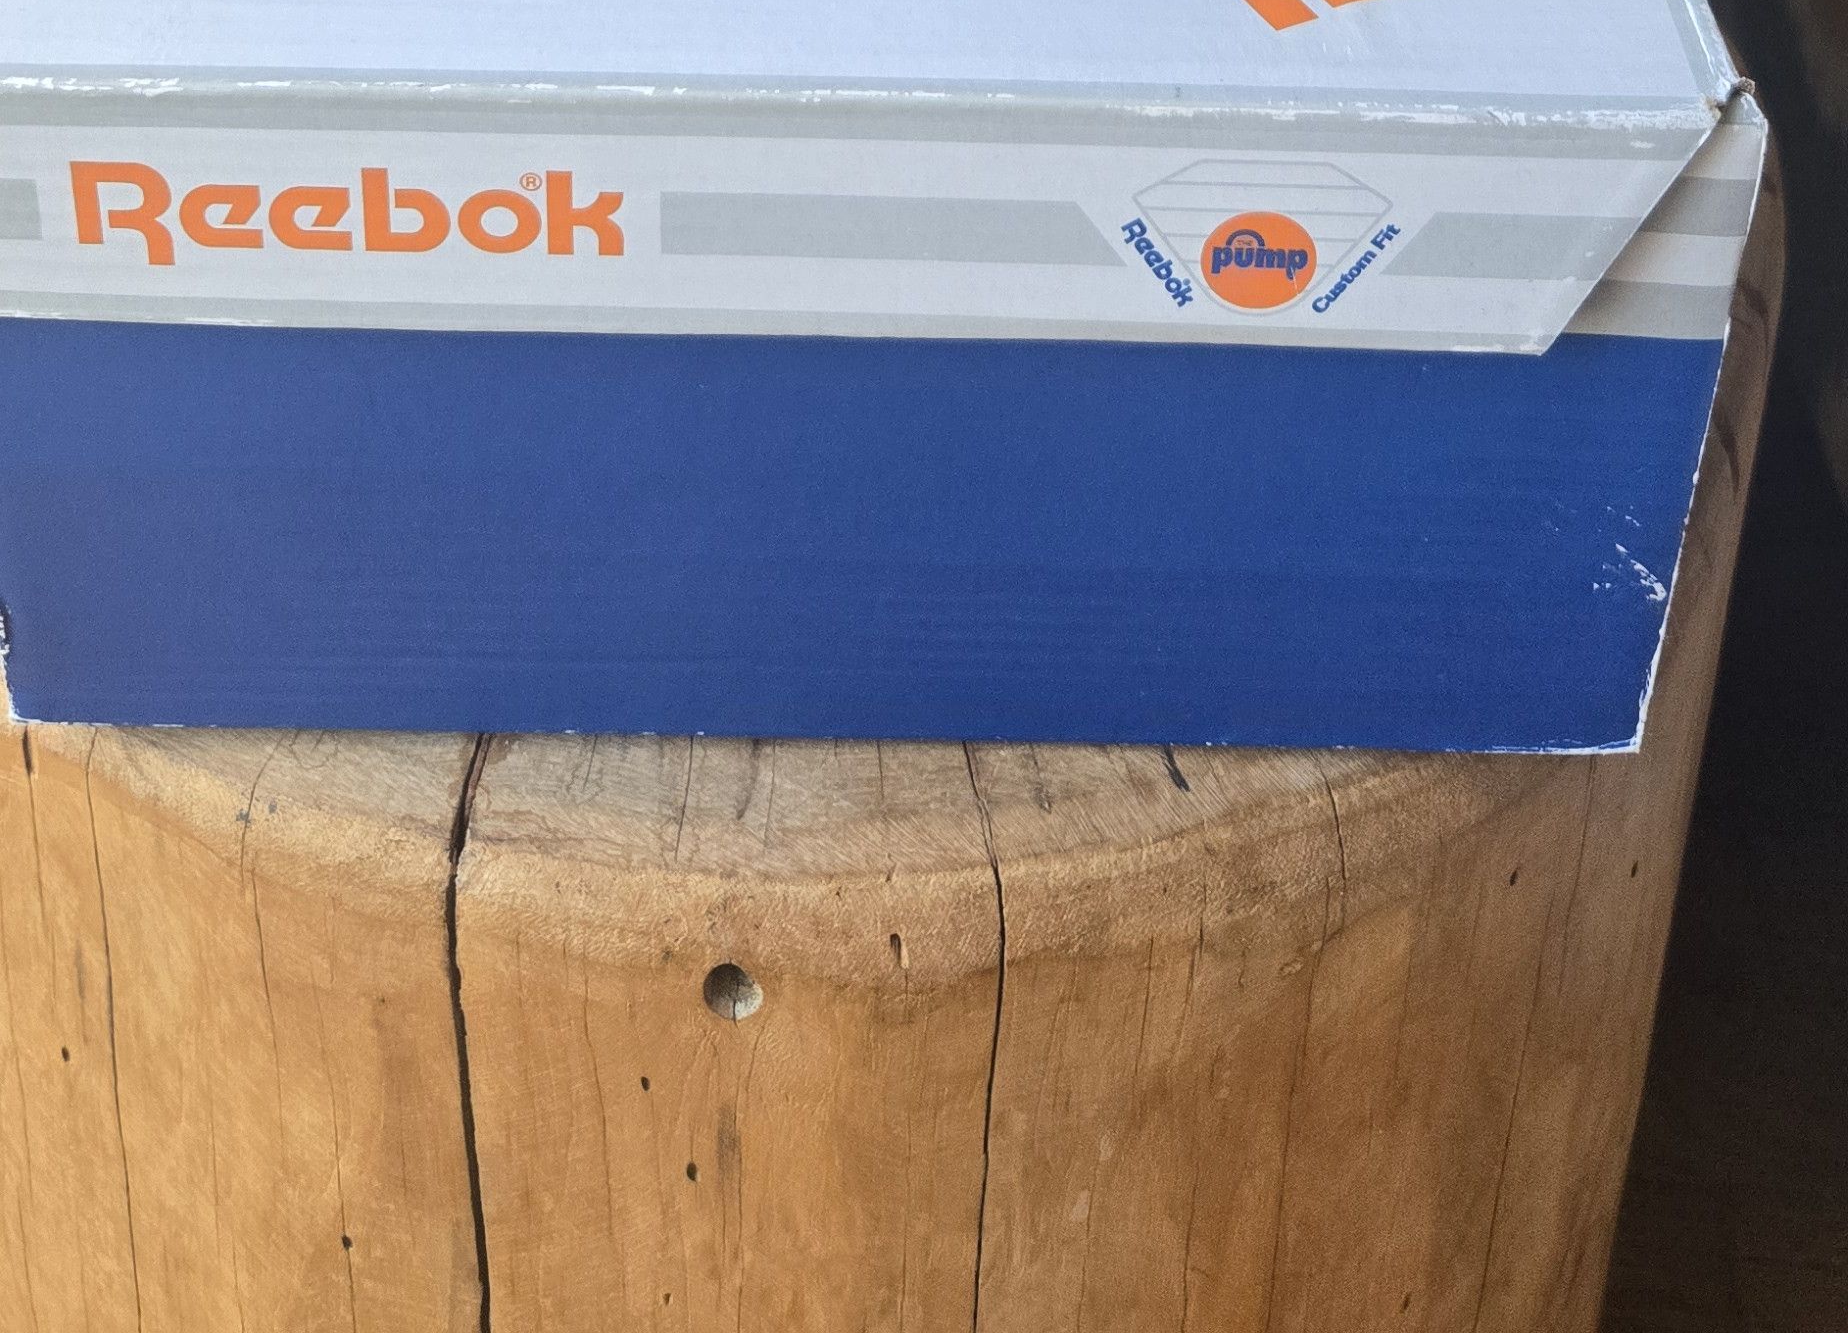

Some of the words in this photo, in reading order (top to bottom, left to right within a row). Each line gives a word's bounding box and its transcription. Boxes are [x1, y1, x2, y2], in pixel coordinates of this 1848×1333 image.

[69, 160, 625, 266] Reebok
[1120, 217, 1194, 308] Reebok
[1210, 245, 1308, 281] pump
[1311, 250, 1377, 313] Custom
[1370, 223, 1401, 251] Fit
